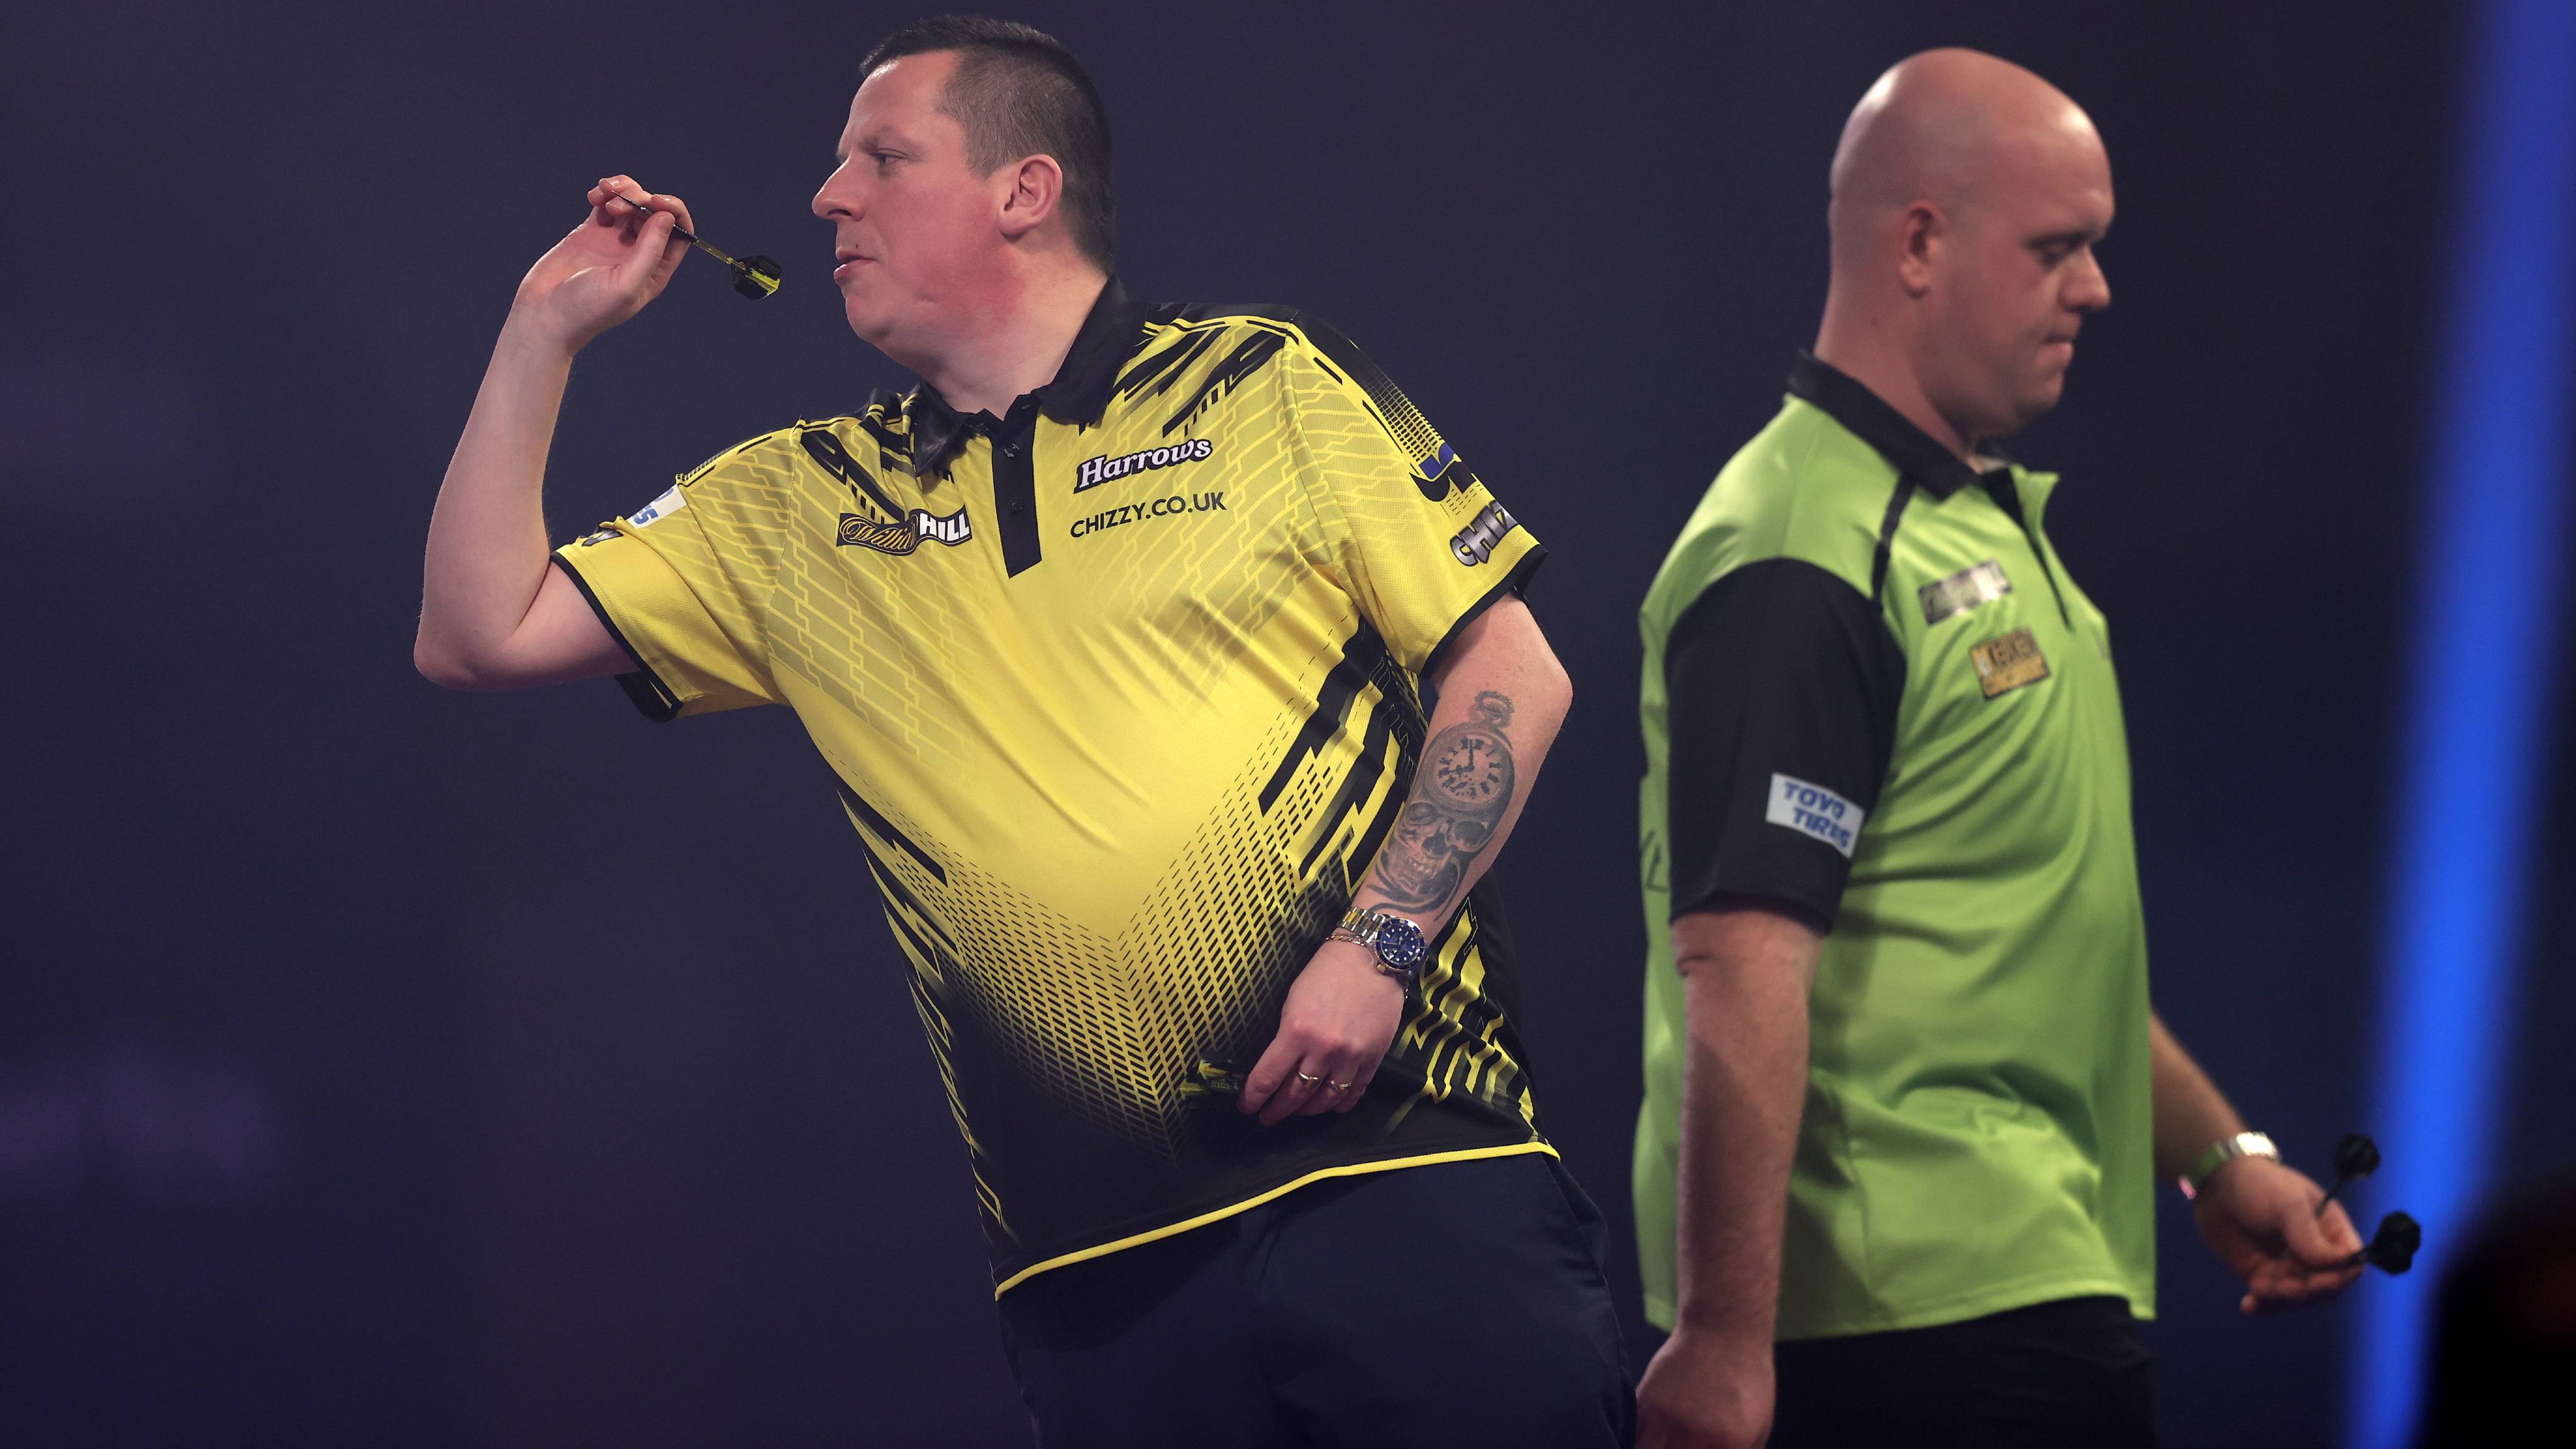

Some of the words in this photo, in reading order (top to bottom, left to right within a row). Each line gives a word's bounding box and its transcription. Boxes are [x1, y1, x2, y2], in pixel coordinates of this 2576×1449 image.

[1075, 439, 1213, 492] Harrows
[919, 513, 970, 541] HILL
[1070, 492, 1227, 538] CHIZZY.CO.UK
